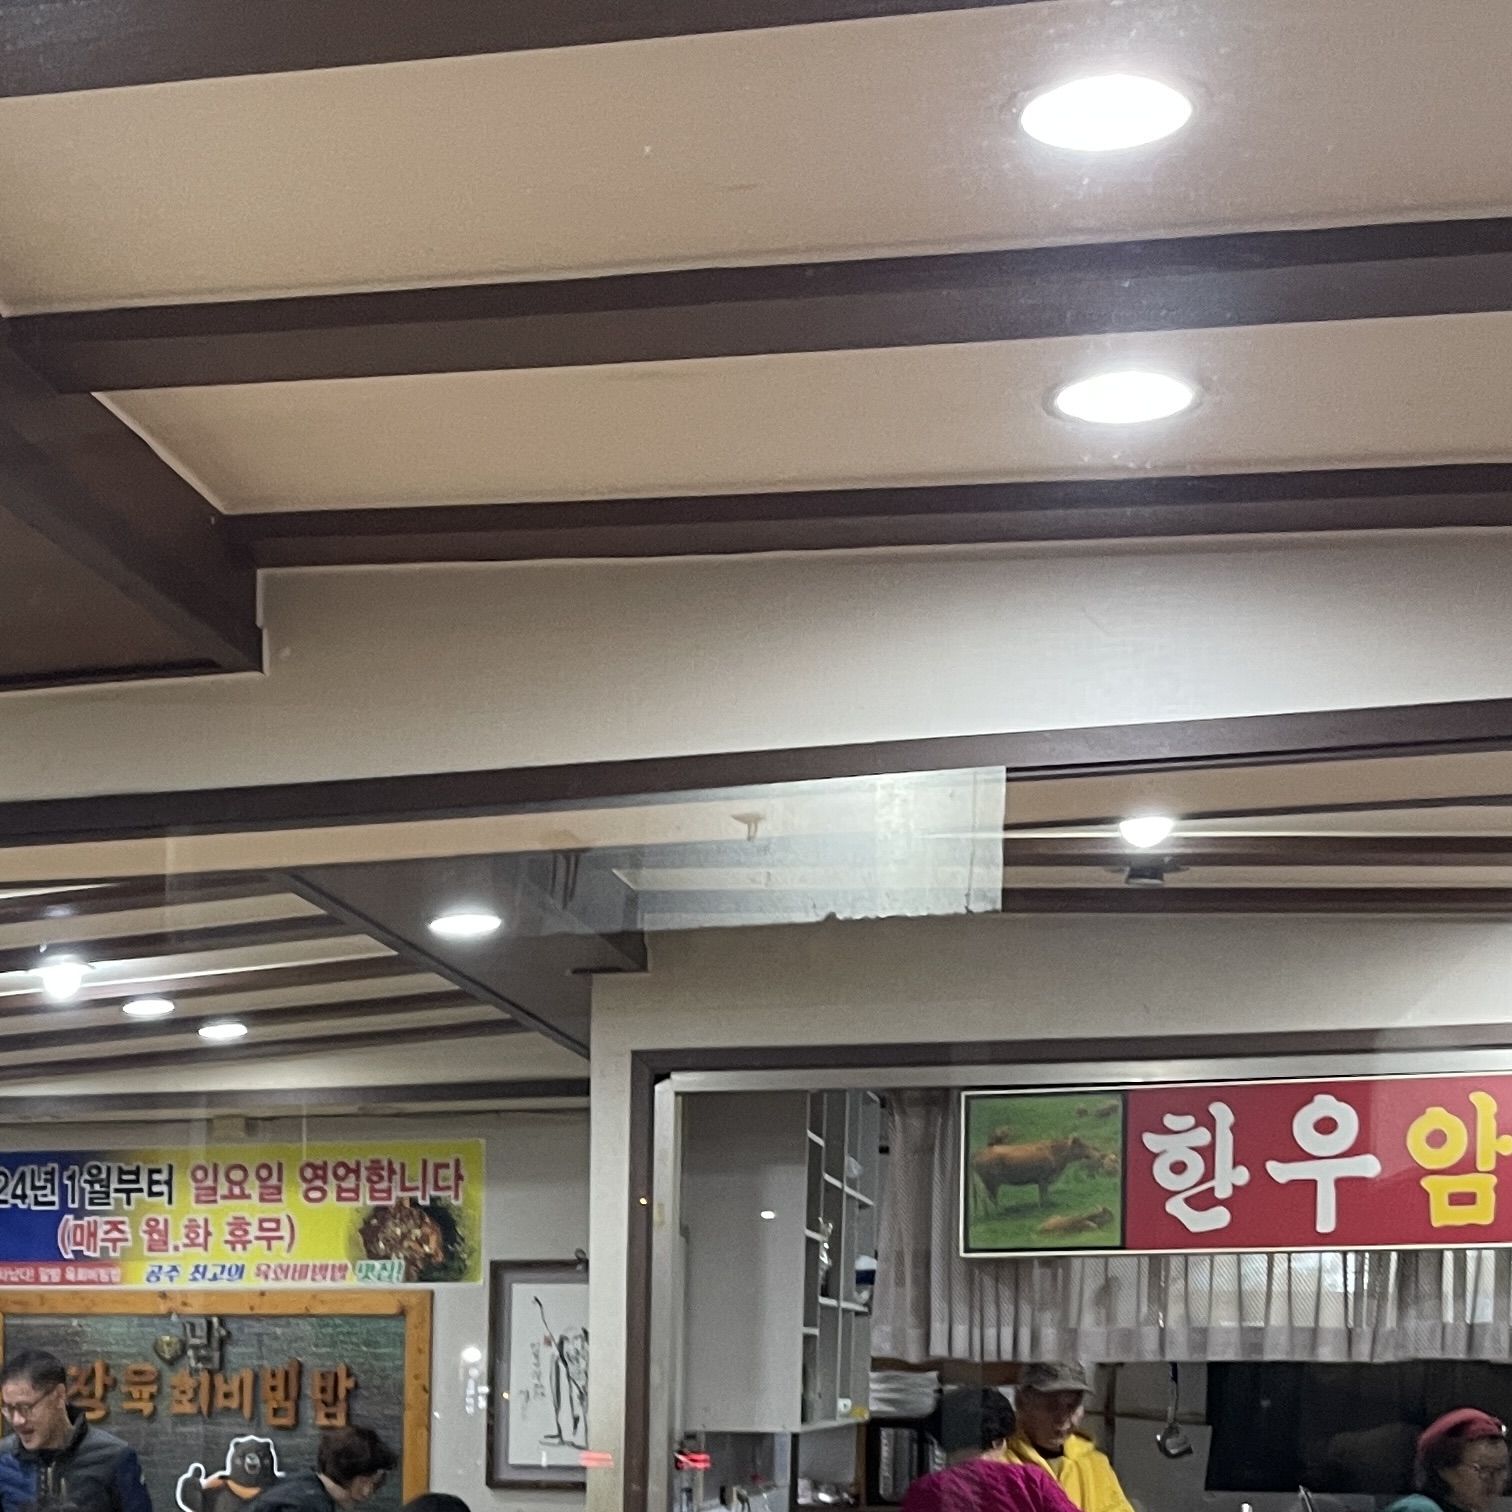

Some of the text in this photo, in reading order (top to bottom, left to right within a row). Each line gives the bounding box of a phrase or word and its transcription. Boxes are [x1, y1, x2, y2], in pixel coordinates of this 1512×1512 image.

[190, 1160, 285, 1203] 일요일
[299, 1158, 465, 1203] 영업합니다
[58, 1215, 130, 1258] (매주
[224, 1214, 295, 1254] 휴무)
[145, 1263, 180, 1283] 공주
[188, 1262, 246, 1282] 최고의
